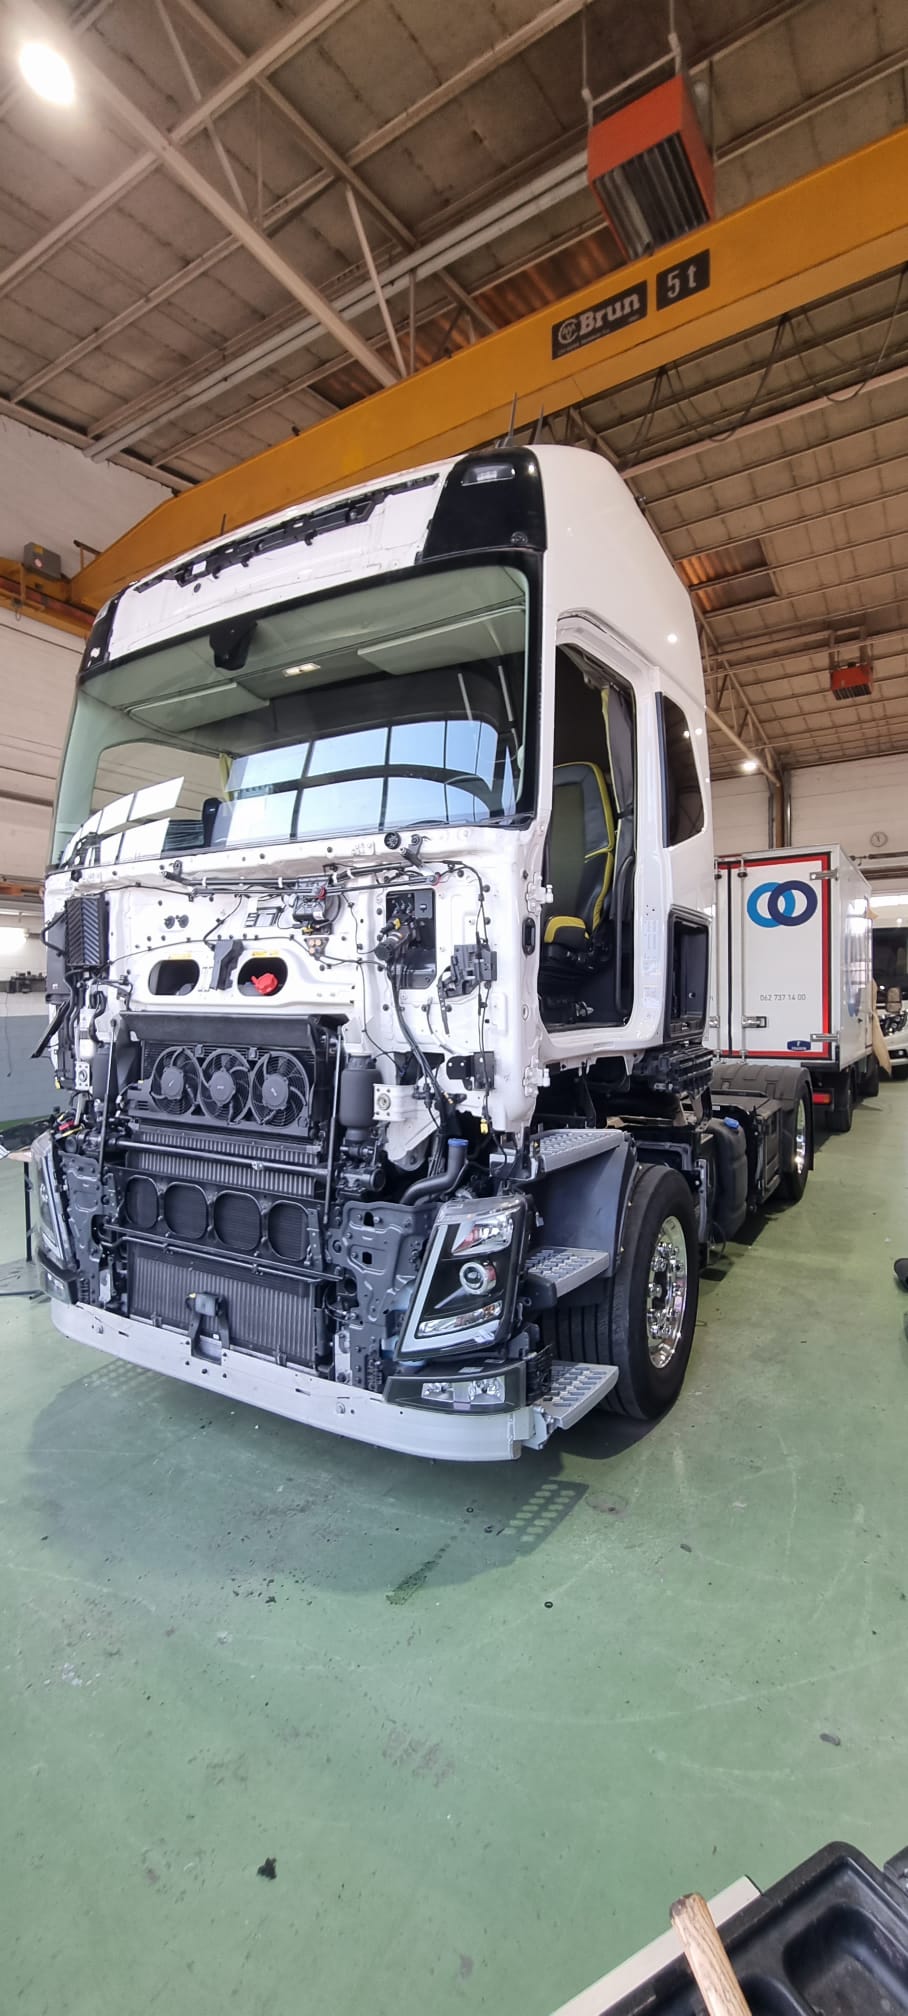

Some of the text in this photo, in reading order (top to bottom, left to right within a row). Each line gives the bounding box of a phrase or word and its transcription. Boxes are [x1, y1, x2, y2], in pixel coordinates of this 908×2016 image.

[667, 264, 697, 298] 5 t
[579, 293, 641, 336] Brun
[774, 993, 785, 1001] 737
[788, 993, 796, 1001] 14
[798, 993, 806, 1001] 00
